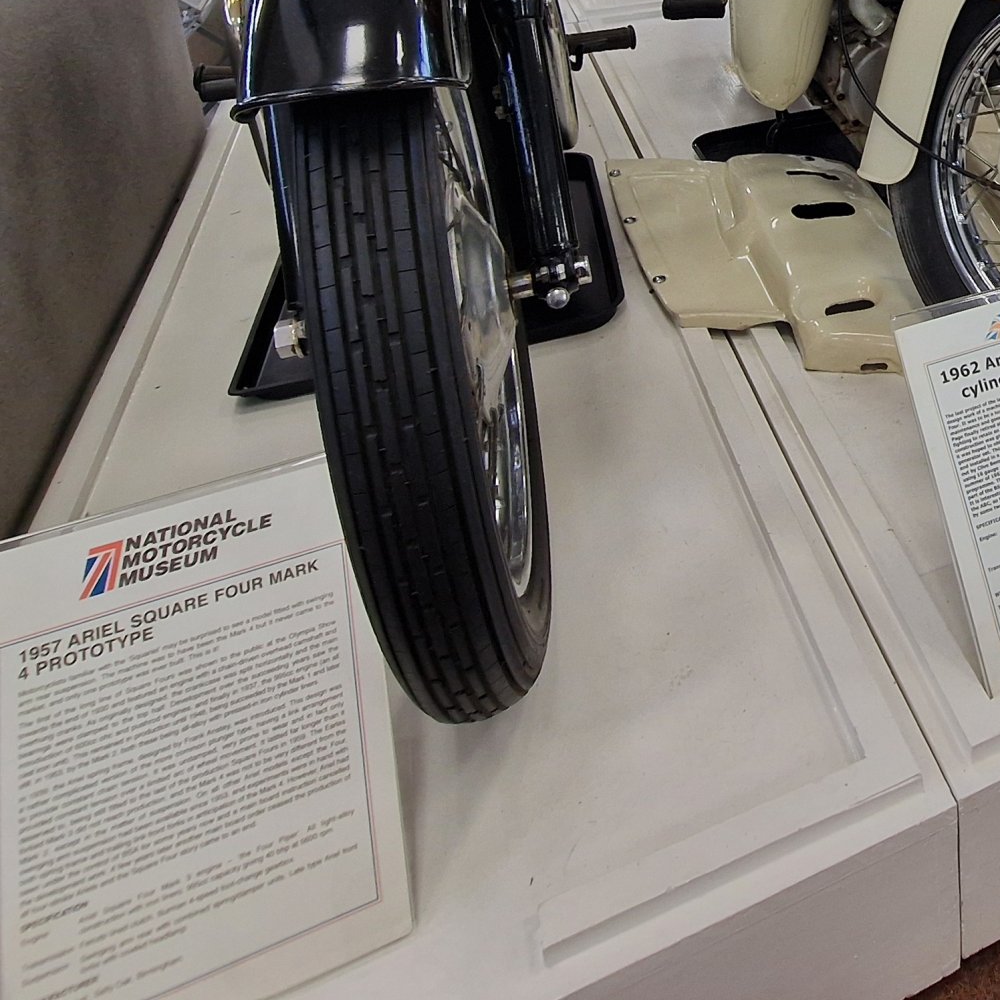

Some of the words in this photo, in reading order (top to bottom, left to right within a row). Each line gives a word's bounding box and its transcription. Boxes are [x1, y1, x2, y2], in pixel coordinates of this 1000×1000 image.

[940, 360, 980, 383] 1962
[121, 513, 273, 570] MOTORCYCLE
[124, 509, 237, 552] NATIONAL
[118, 545, 218, 589] MUSEUM
[18, 638, 62, 663] 1957
[67, 620, 125, 648] ARIEL
[130, 592, 208, 628] SQUARE
[214, 576, 262, 602] FOUR
[268, 558, 318, 585] MARK
[18, 666, 29, 679] 4
[36, 626, 153, 675] PROTOTYPE
